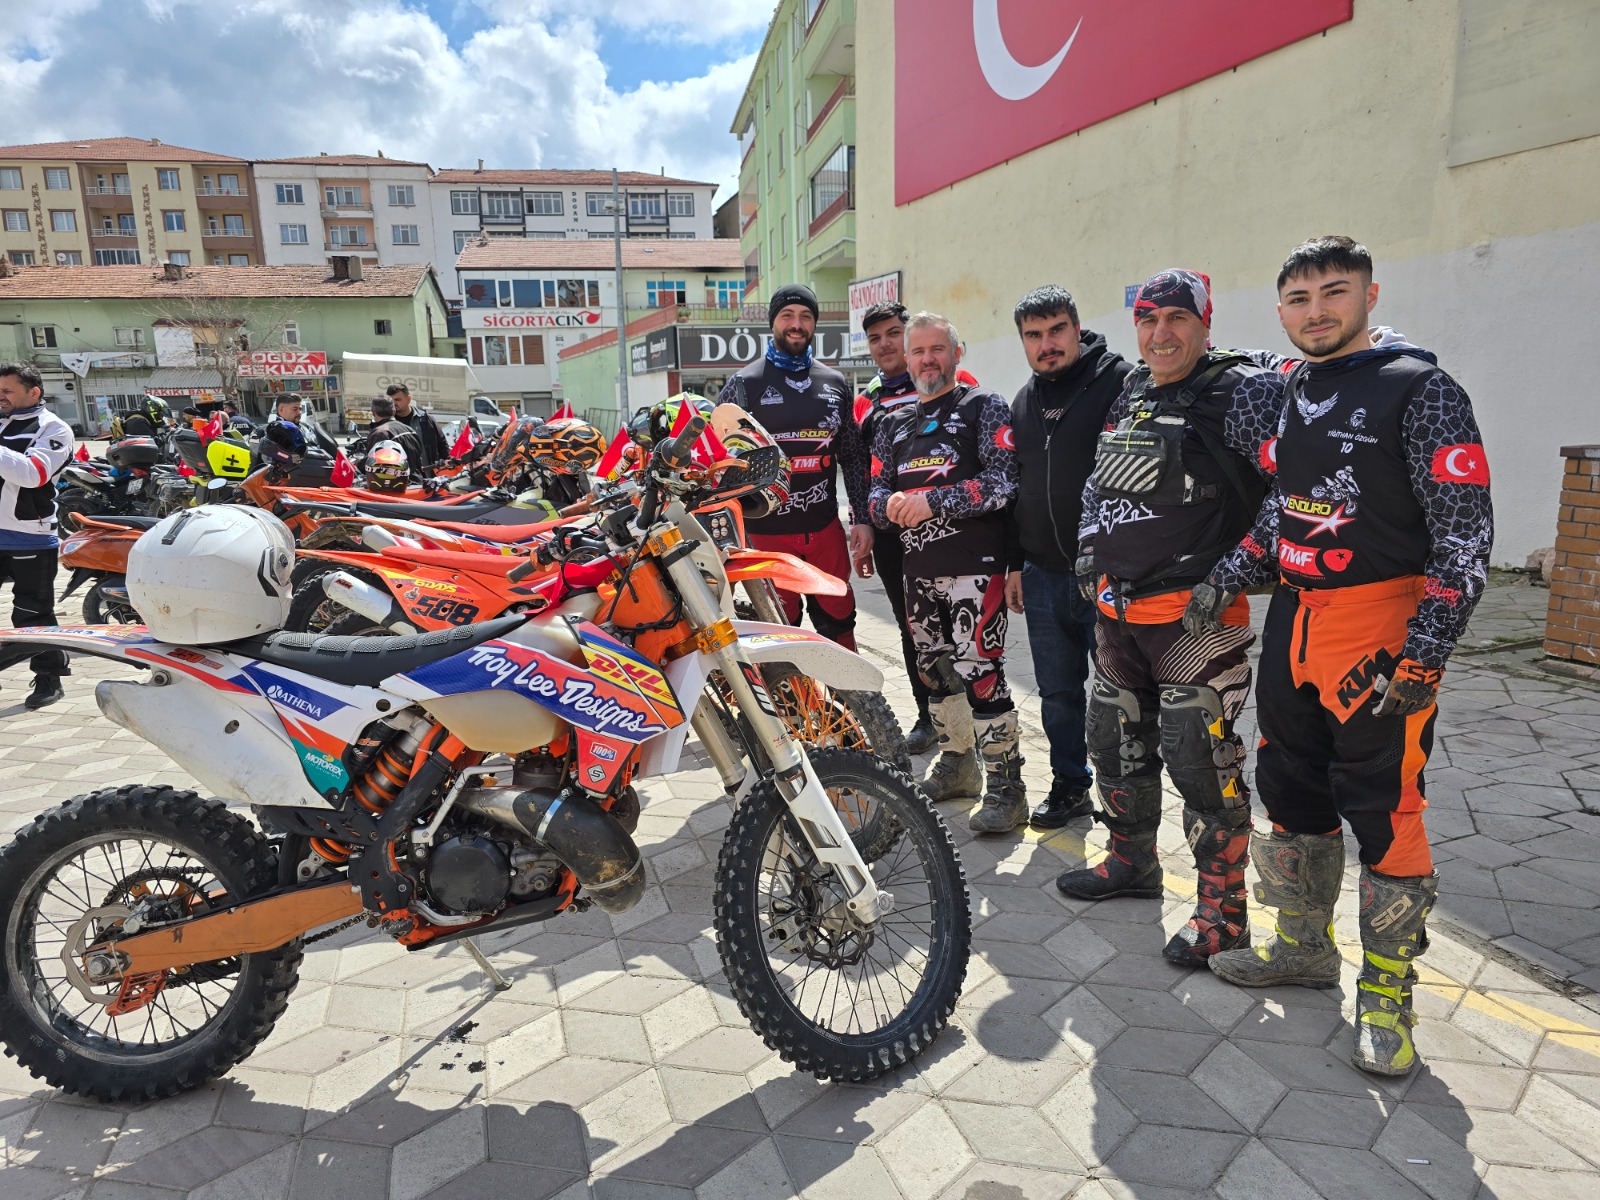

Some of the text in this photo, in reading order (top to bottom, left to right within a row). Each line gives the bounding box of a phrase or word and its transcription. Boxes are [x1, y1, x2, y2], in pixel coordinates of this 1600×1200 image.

[238, 364, 326, 375] REKLAM
[1340, 441, 1354, 454] 10
[793, 458, 820, 469] TMF
[1280, 543, 1314, 567] TMF
[590, 653, 664, 694] DHL
[467, 645, 663, 733] Troy Lee Designs
[280, 692, 322, 718] ATHENA
[593, 743, 614, 760] 100%
[304, 752, 343, 776] MOTOREX
[1370, 894, 1413, 933] SIDI
